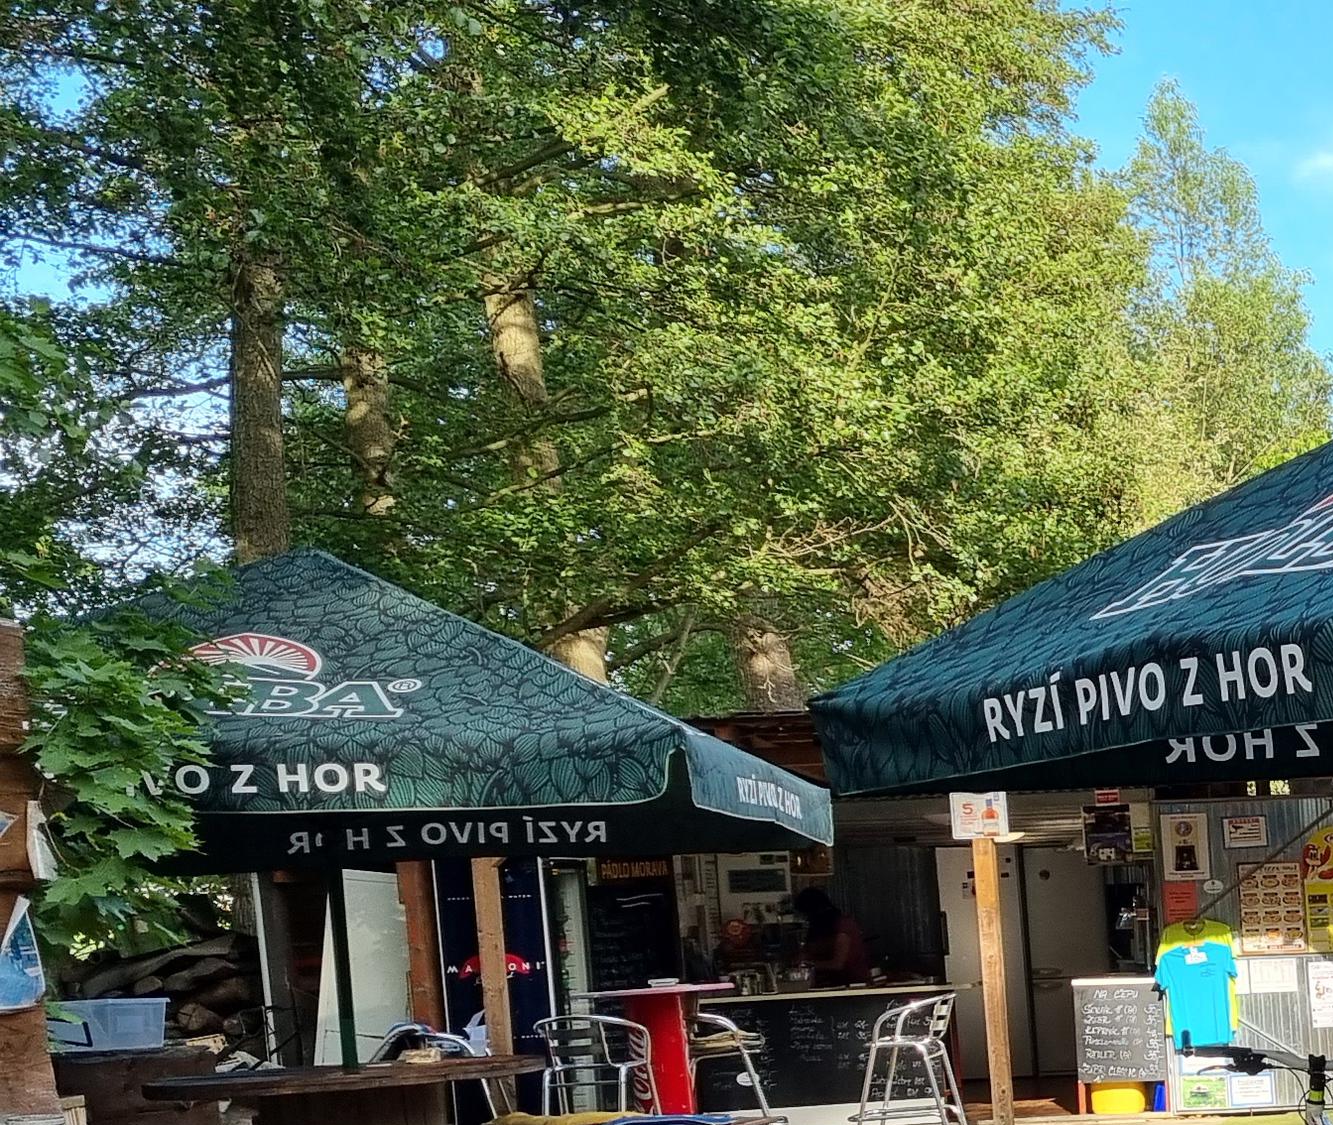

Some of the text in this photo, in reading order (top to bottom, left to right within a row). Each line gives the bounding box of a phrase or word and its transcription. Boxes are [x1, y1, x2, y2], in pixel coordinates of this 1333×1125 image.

[983, 643, 1314, 743] RYZÍ PIVO Z HOR
[230, 764, 258, 794] Z
[276, 762, 388, 795] HOR
[446, 960, 545, 975] MAONI
